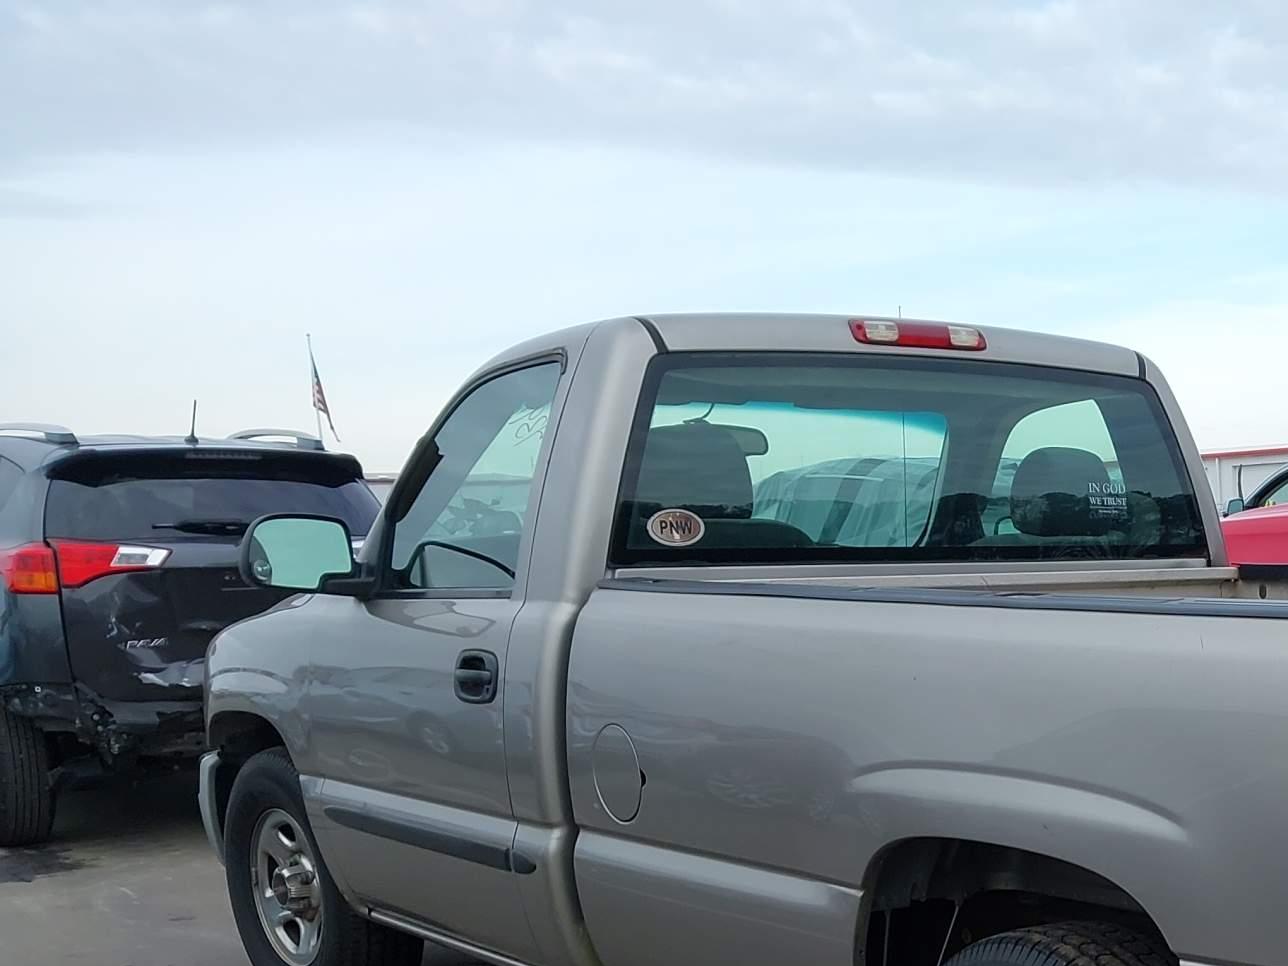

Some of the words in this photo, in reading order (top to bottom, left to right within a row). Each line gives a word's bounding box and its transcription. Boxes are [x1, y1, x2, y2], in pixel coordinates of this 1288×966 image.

[1088, 482, 1100, 493] IN
[1102, 482, 1126, 494] GOD
[1089, 496, 1102, 505] WE
[1102, 497, 1127, 506] TRUST
[659, 519, 692, 535] PNW
